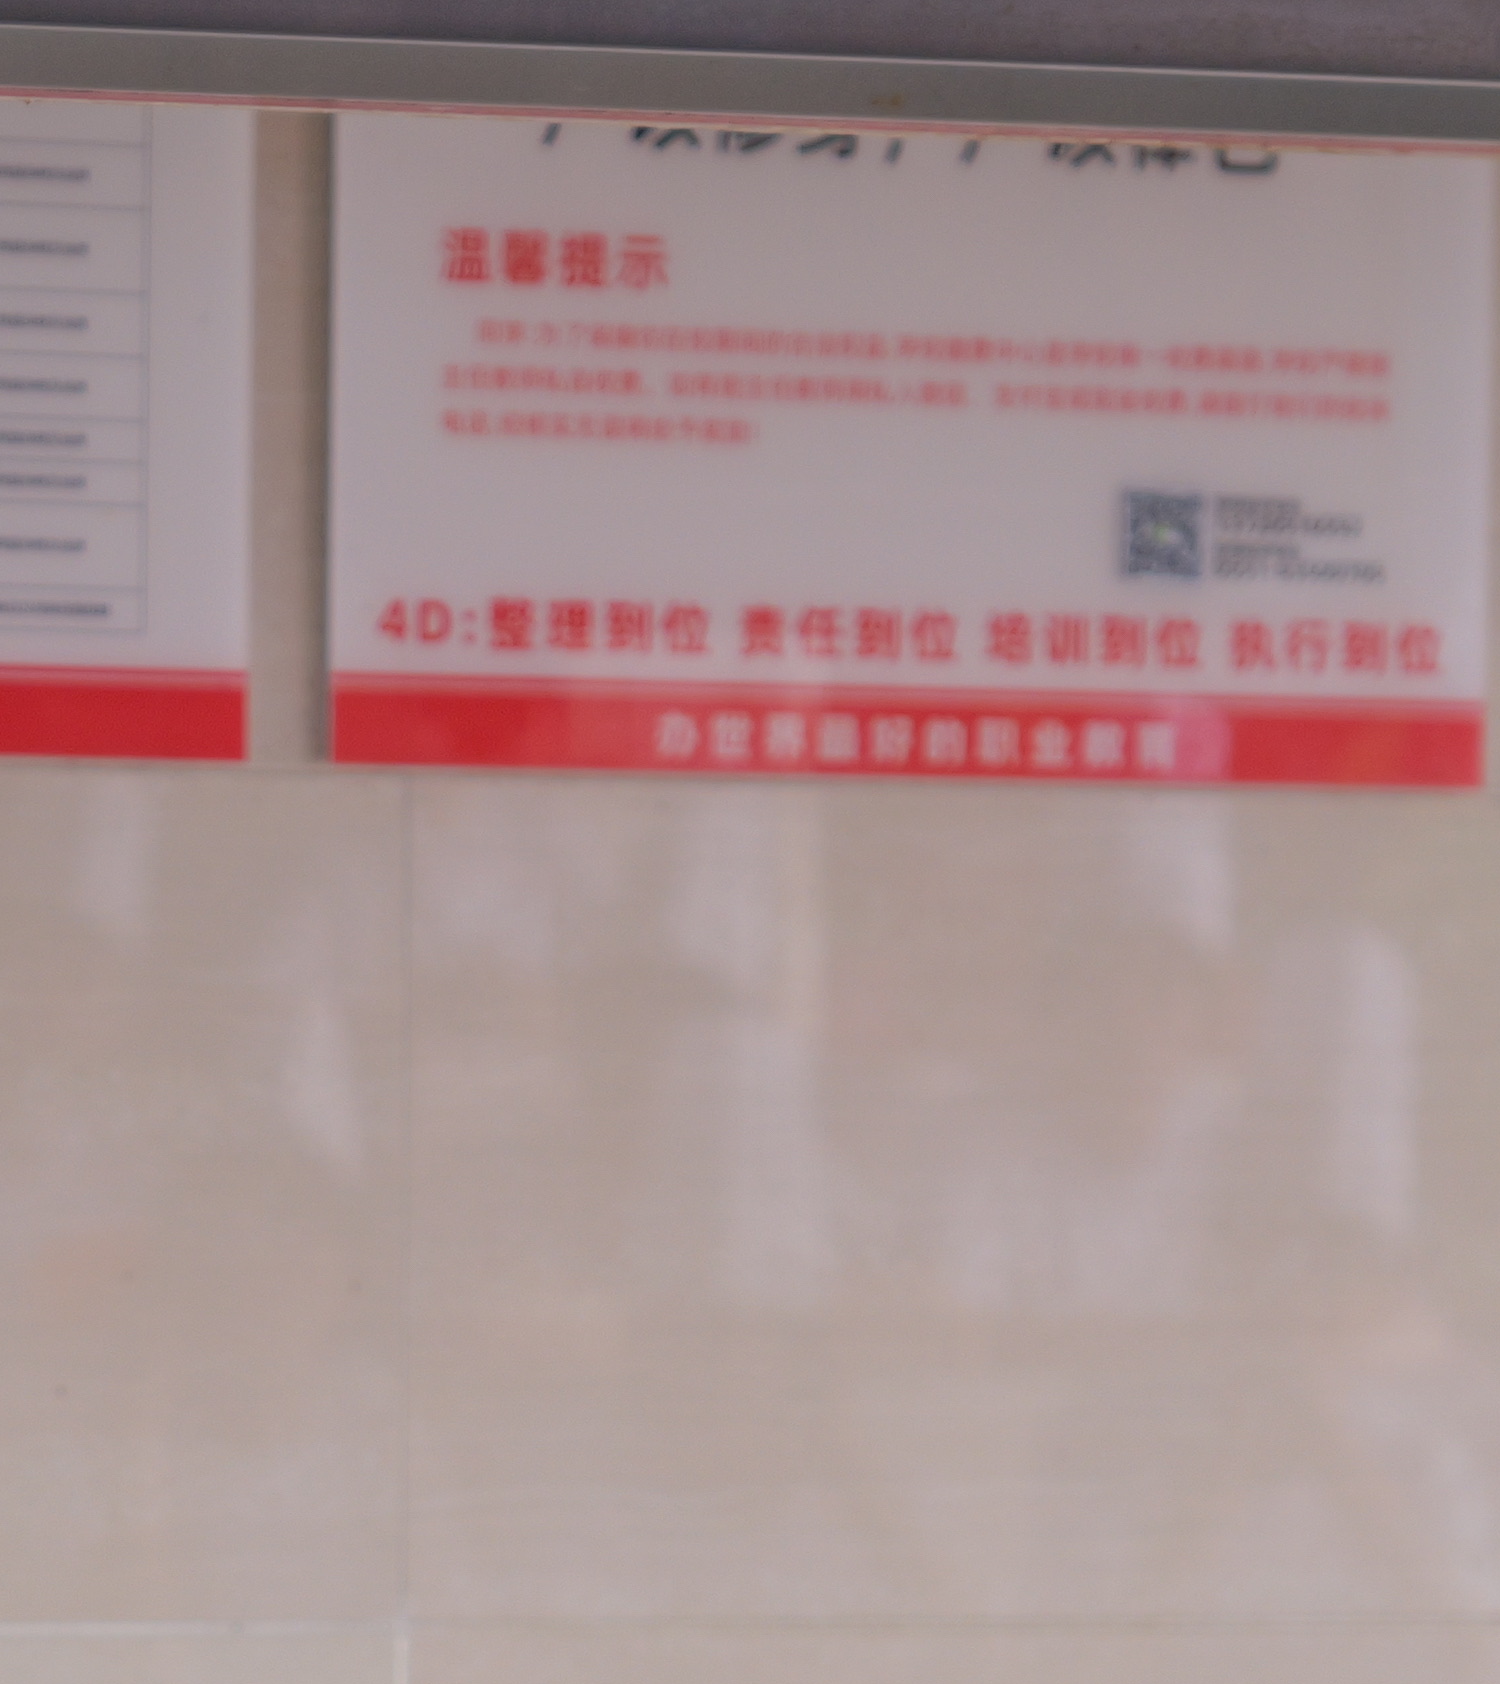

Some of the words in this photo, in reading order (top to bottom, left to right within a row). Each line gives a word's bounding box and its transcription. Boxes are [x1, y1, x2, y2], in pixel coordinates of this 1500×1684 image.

[740, 605, 958, 663] 责任到位
[986, 611, 1201, 672] 培训到位
[1228, 619, 1443, 677] 执行到位
